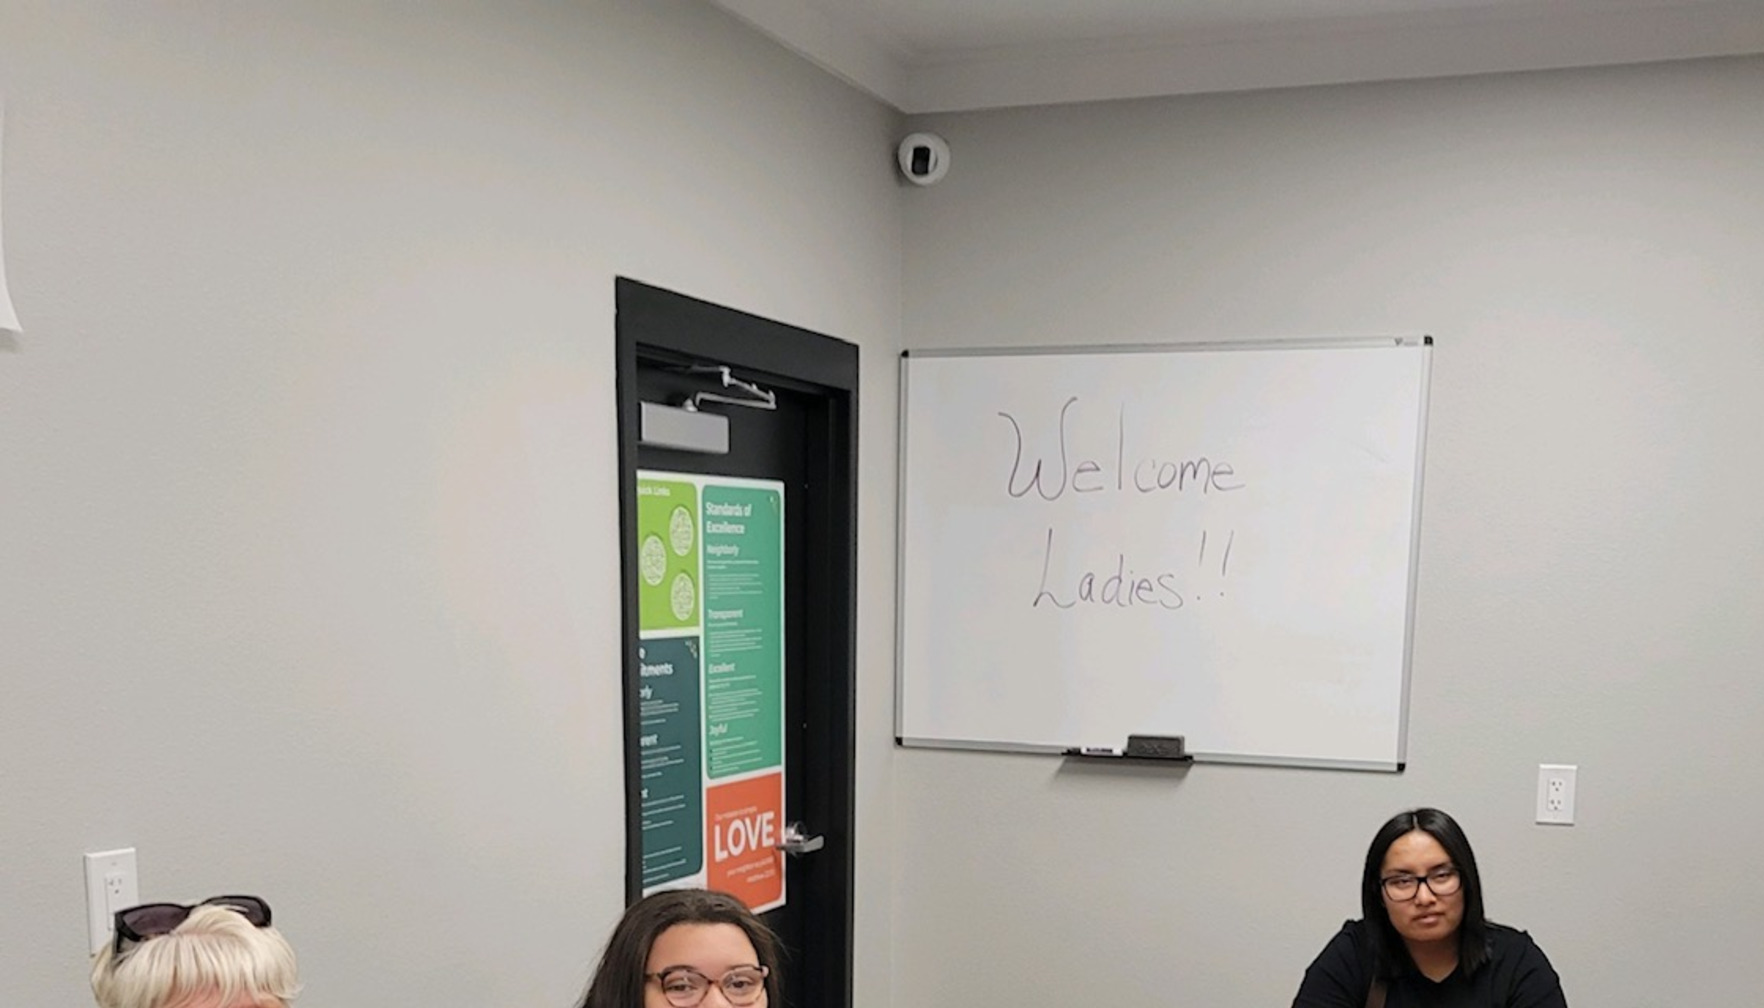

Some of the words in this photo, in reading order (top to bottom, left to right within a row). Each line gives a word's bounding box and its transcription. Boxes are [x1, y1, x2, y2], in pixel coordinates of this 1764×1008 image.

[997, 396, 1247, 502] Welcome
[706, 502, 742, 517] Standards
[743, 503, 753, 517] of
[706, 521, 745, 535] Excellence
[1032, 528, 1236, 610] Ladies!!
[708, 662, 736, 675] Excellent
[714, 810, 775, 863] LOVE
